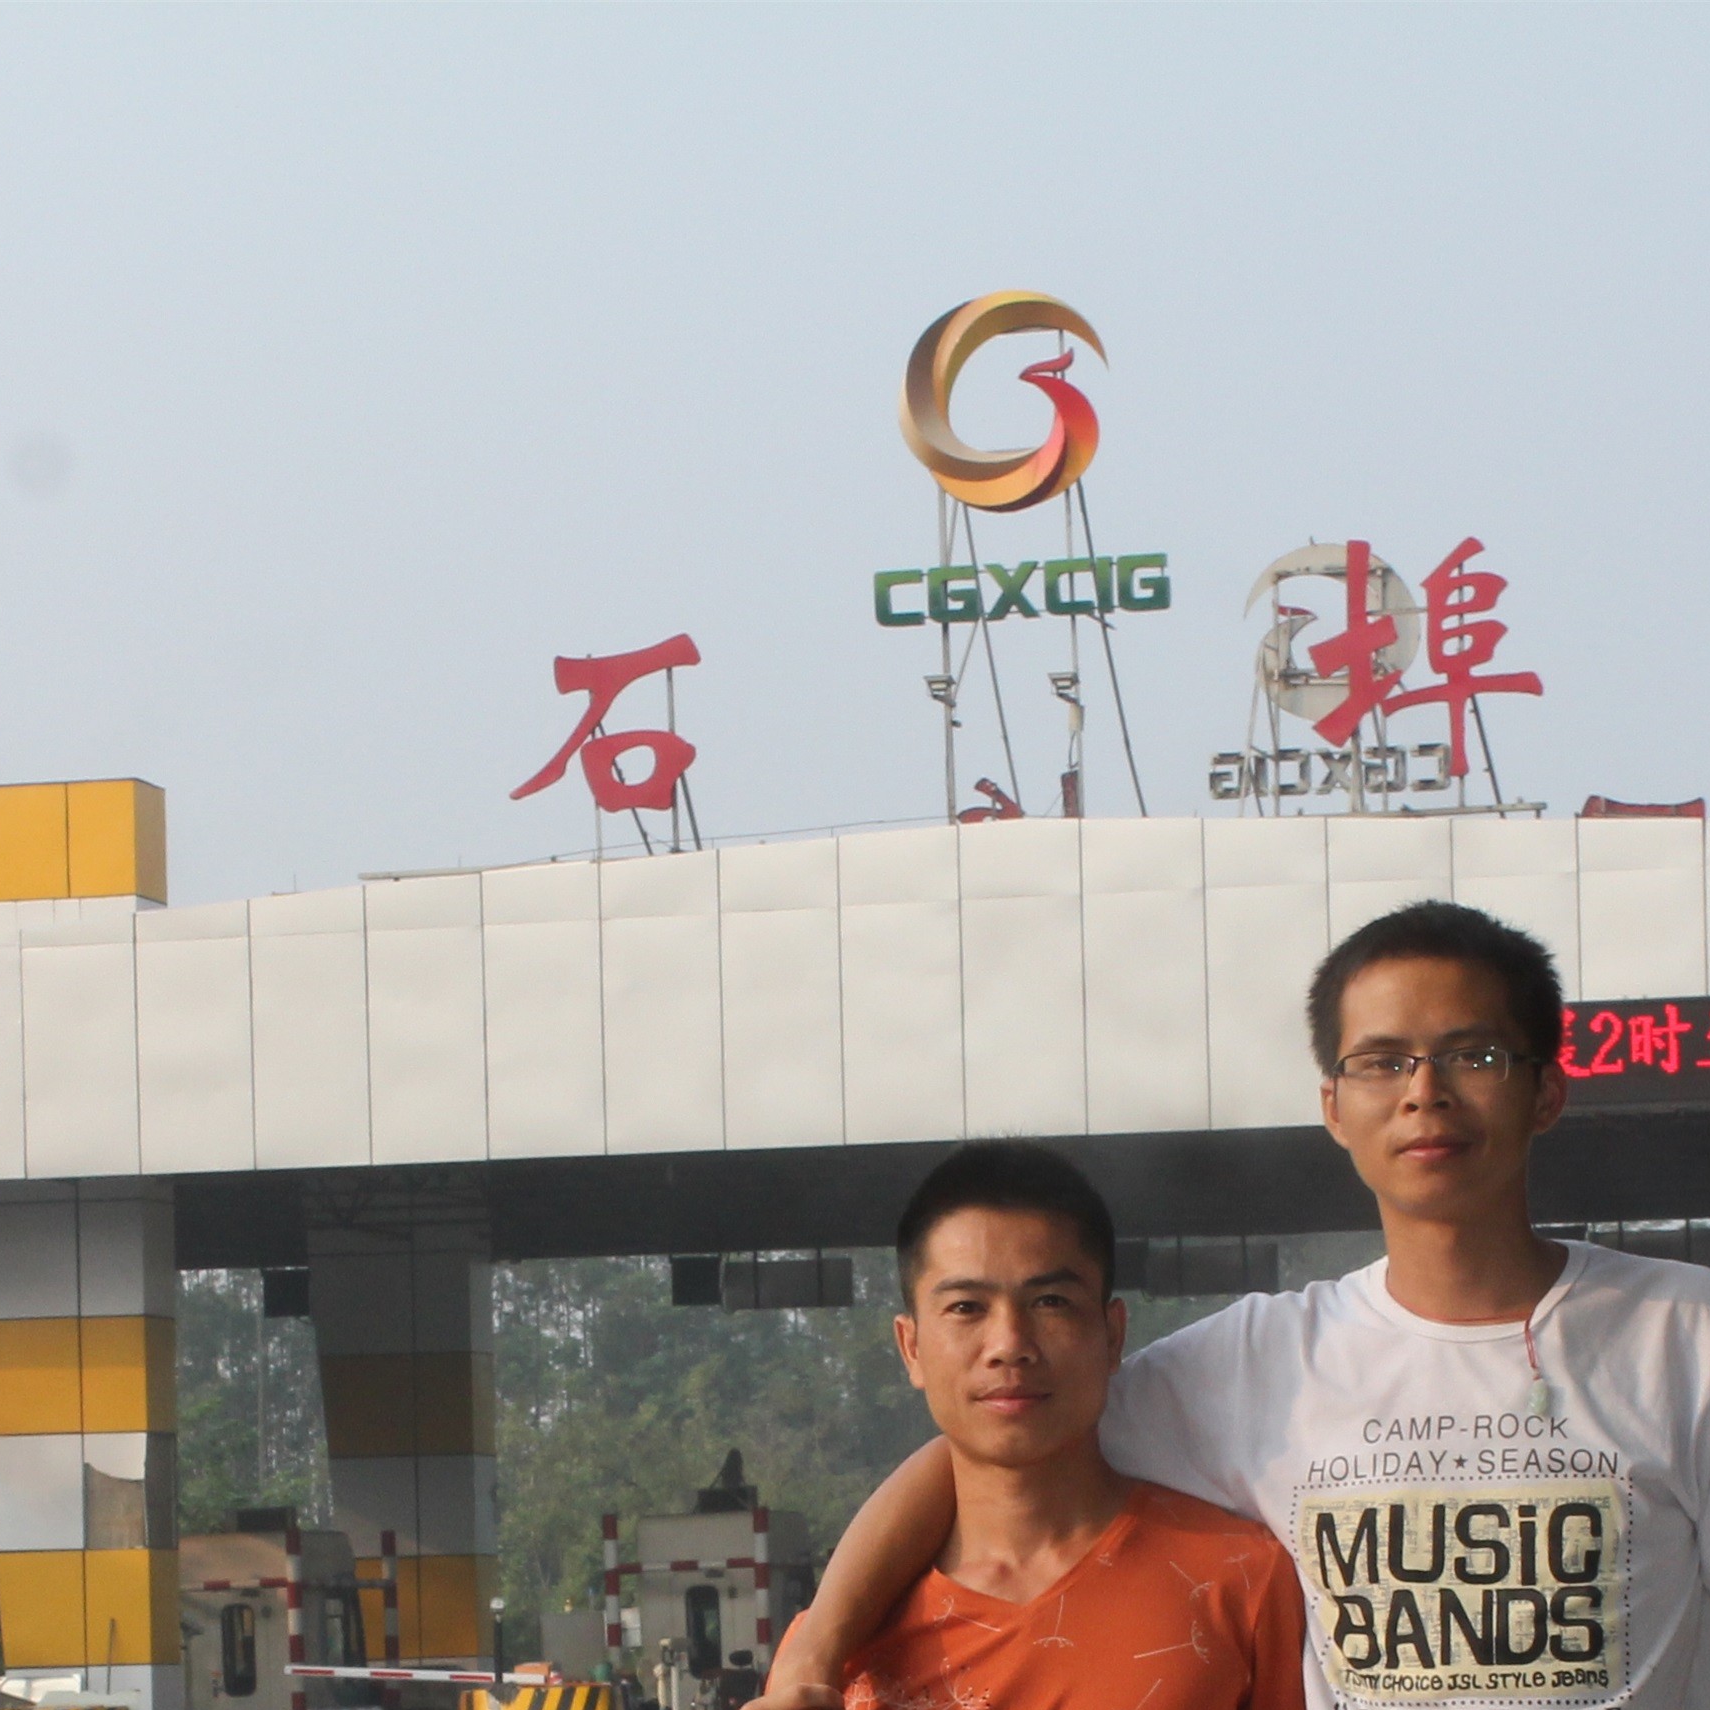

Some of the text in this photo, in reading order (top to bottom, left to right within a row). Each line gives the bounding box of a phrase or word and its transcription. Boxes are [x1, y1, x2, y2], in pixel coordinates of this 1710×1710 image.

[874, 552, 1171, 627] CGXCIG
[509, 536, 1545, 814] 石 埠
[1307, 1447, 1619, 1483] HOLIDAY SEASON
[1362, 1413, 1569, 1444] CAMP-ROCK
[1333, 1586, 1604, 1670] BANDS
